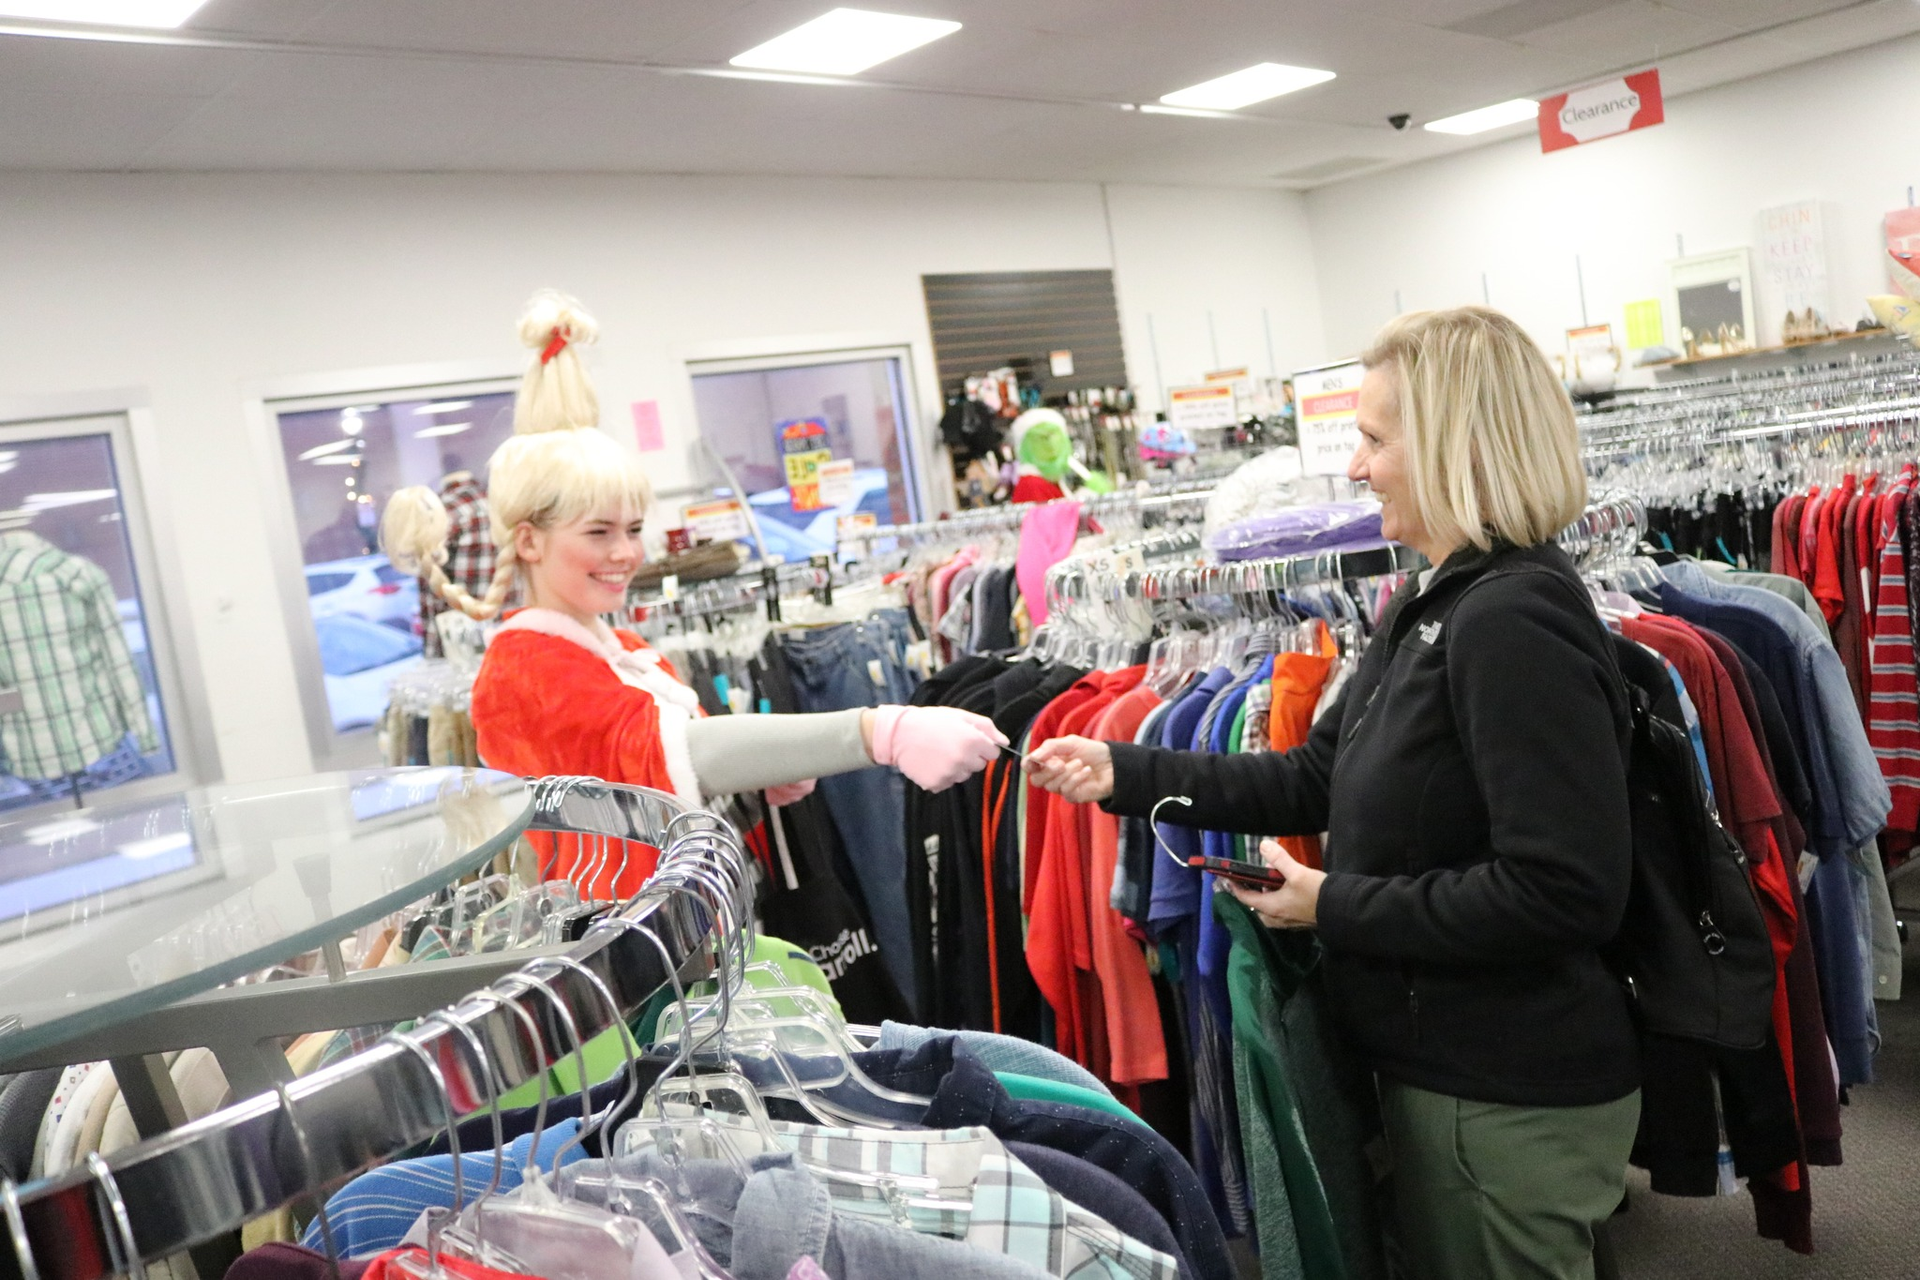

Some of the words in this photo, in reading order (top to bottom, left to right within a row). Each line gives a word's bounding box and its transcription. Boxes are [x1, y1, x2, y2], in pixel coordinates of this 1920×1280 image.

[1561, 94, 1639, 125] Clearance
[1313, 396, 1354, 414] CLEARANCE
[1087, 558, 1110, 575] XS
[1125, 556, 1133, 569] S
